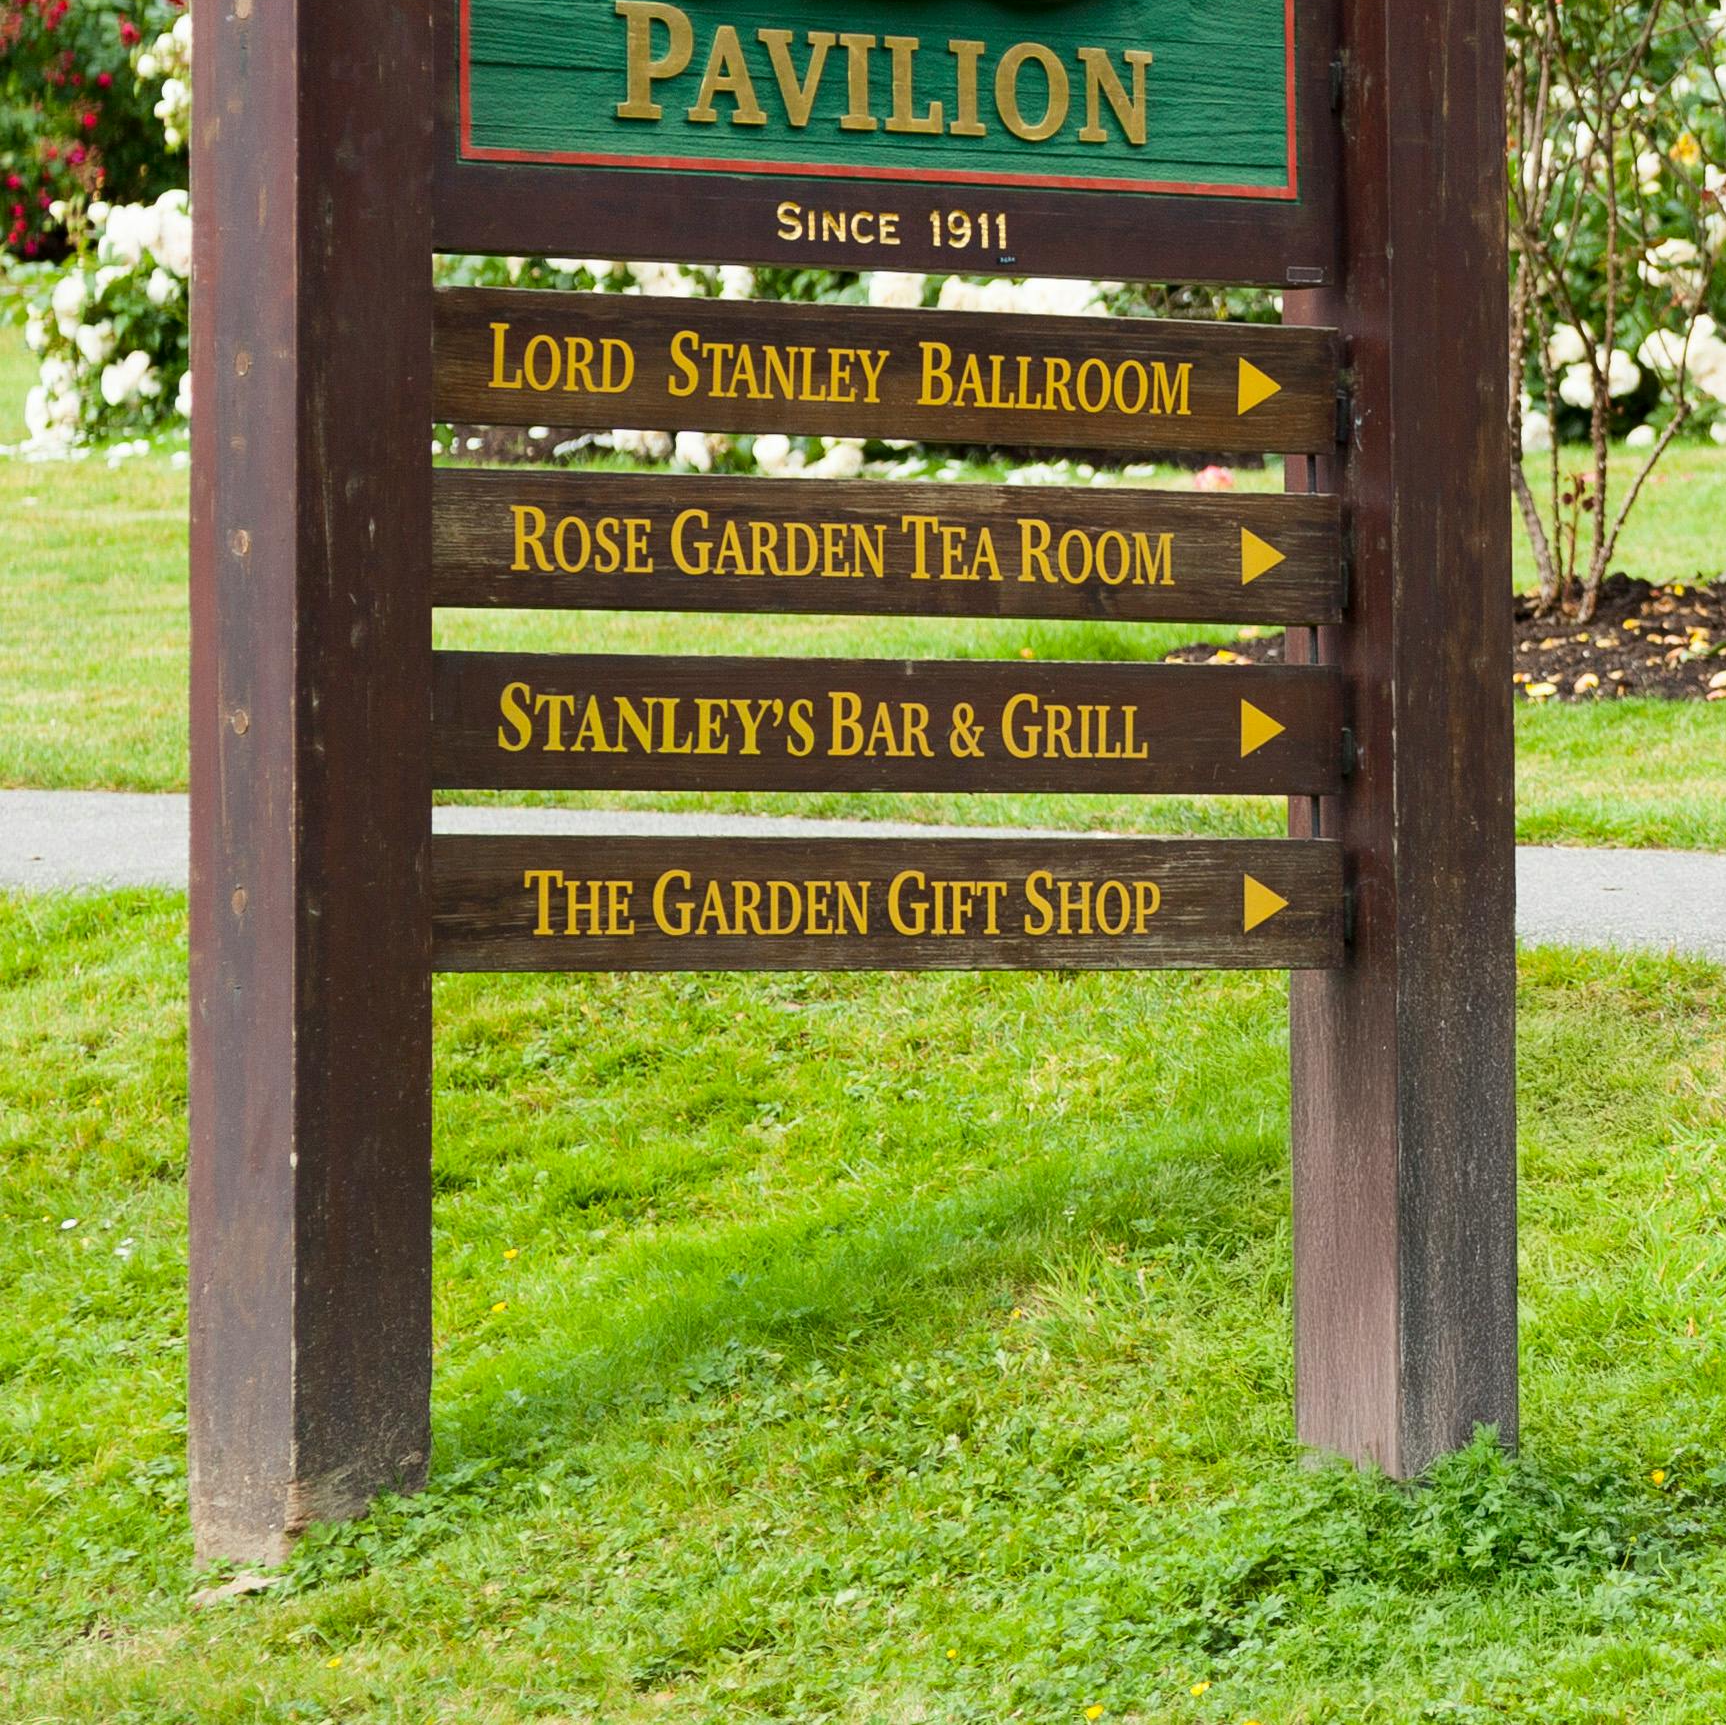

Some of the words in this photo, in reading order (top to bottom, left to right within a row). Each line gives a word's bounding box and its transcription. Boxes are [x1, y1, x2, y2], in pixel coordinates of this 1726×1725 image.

[614, 0, 1152, 145] PAVILION
[777, 201, 900, 246] SINCE
[930, 208, 1007, 249] 1911
[488, 322, 634, 394] LORD
[668, 330, 889, 404] STANLEY
[919, 341, 1192, 416] BALLROOM
[509, 504, 653, 574] ROSE
[670, 508, 886, 578] GARDEN
[902, 515, 1006, 582] TEA
[1018, 519, 1175, 586] ROOM
[497, 682, 814, 755] STANLEY'S
[829, 691, 934, 758] BAR
[950, 702, 984, 758] &
[1002, 693, 1148, 759] GRILL
[523, 869, 634, 936] THE
[653, 869, 869, 936] GARDEN
[889, 869, 1006, 936] GIFT
[1023, 869, 1160, 936] SHOP
